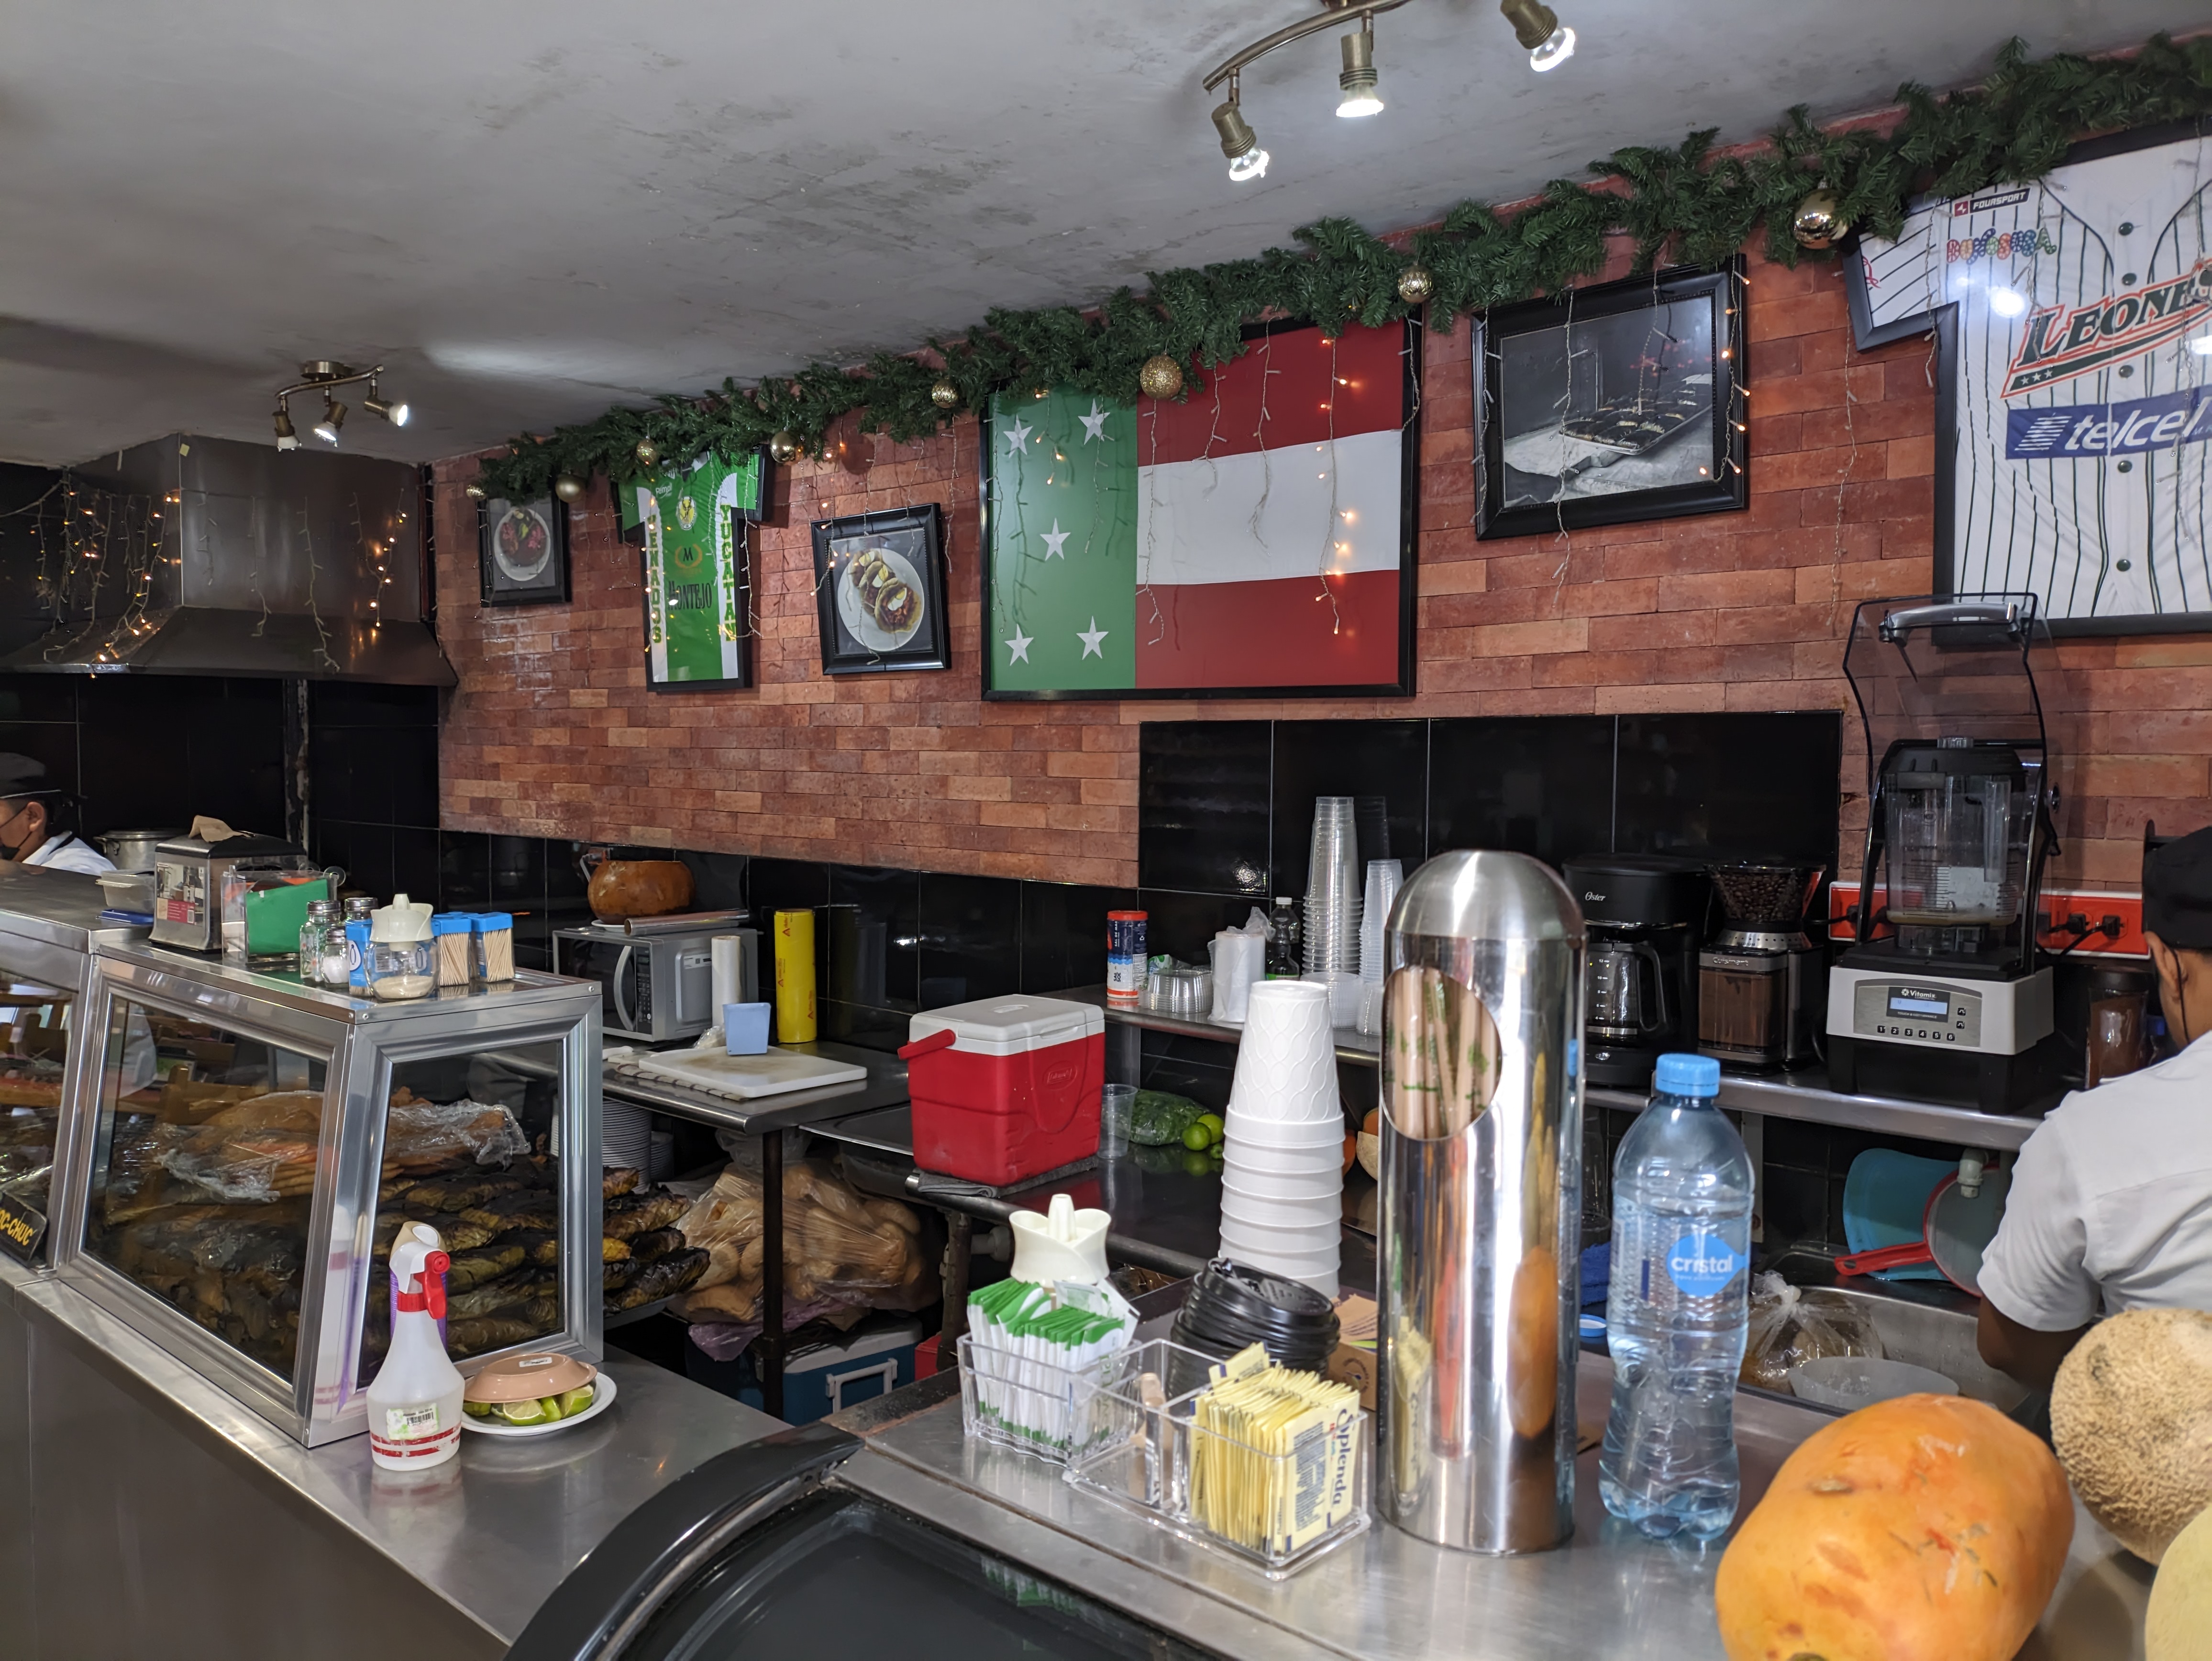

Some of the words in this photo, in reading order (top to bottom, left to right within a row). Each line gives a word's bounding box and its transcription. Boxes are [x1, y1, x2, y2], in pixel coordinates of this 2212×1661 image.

[1973, 192, 2026, 210] FOURSPORT
[2016, 267, 2212, 367] LEONE
[2064, 396, 2212, 450] telcel
[683, 547, 693, 561] M
[720, 505, 736, 642] YUCATAN
[668, 580, 712, 610] MONTEJO
[1585, 892, 1606, 901] Oster
[1910, 990, 1936, 998] Vitamix
[1671, 1254, 1733, 1273] cristal
[1332, 1408, 1354, 1505] Splenda
